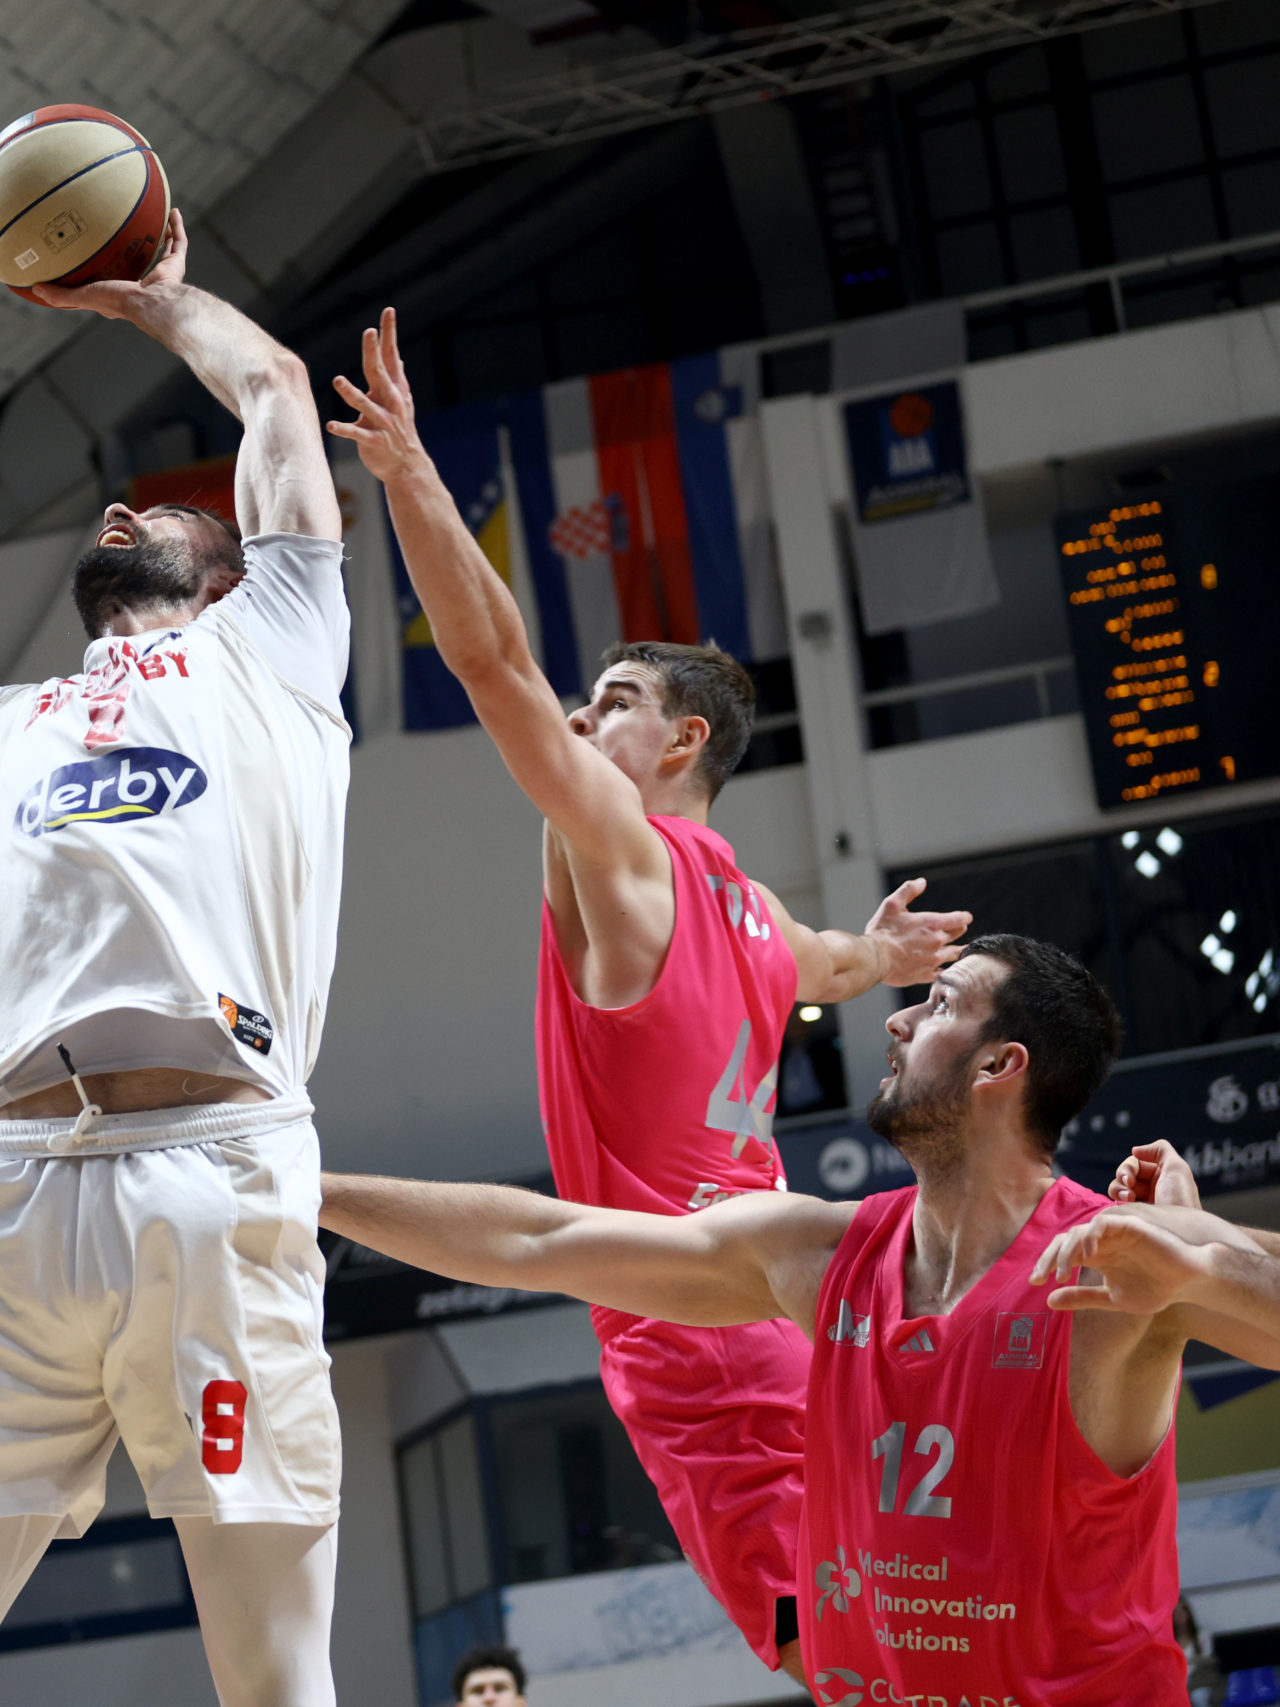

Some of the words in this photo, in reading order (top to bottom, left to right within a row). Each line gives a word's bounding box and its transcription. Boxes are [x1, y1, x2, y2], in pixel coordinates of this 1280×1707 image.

[22, 758, 197, 833] derby
[202, 1379, 248, 1474] 8
[871, 1421, 955, 1519] 12
[858, 1548, 948, 1582] Medical
[874, 1586, 1016, 1621] Innovation
[870, 1617, 971, 1653] olutions
